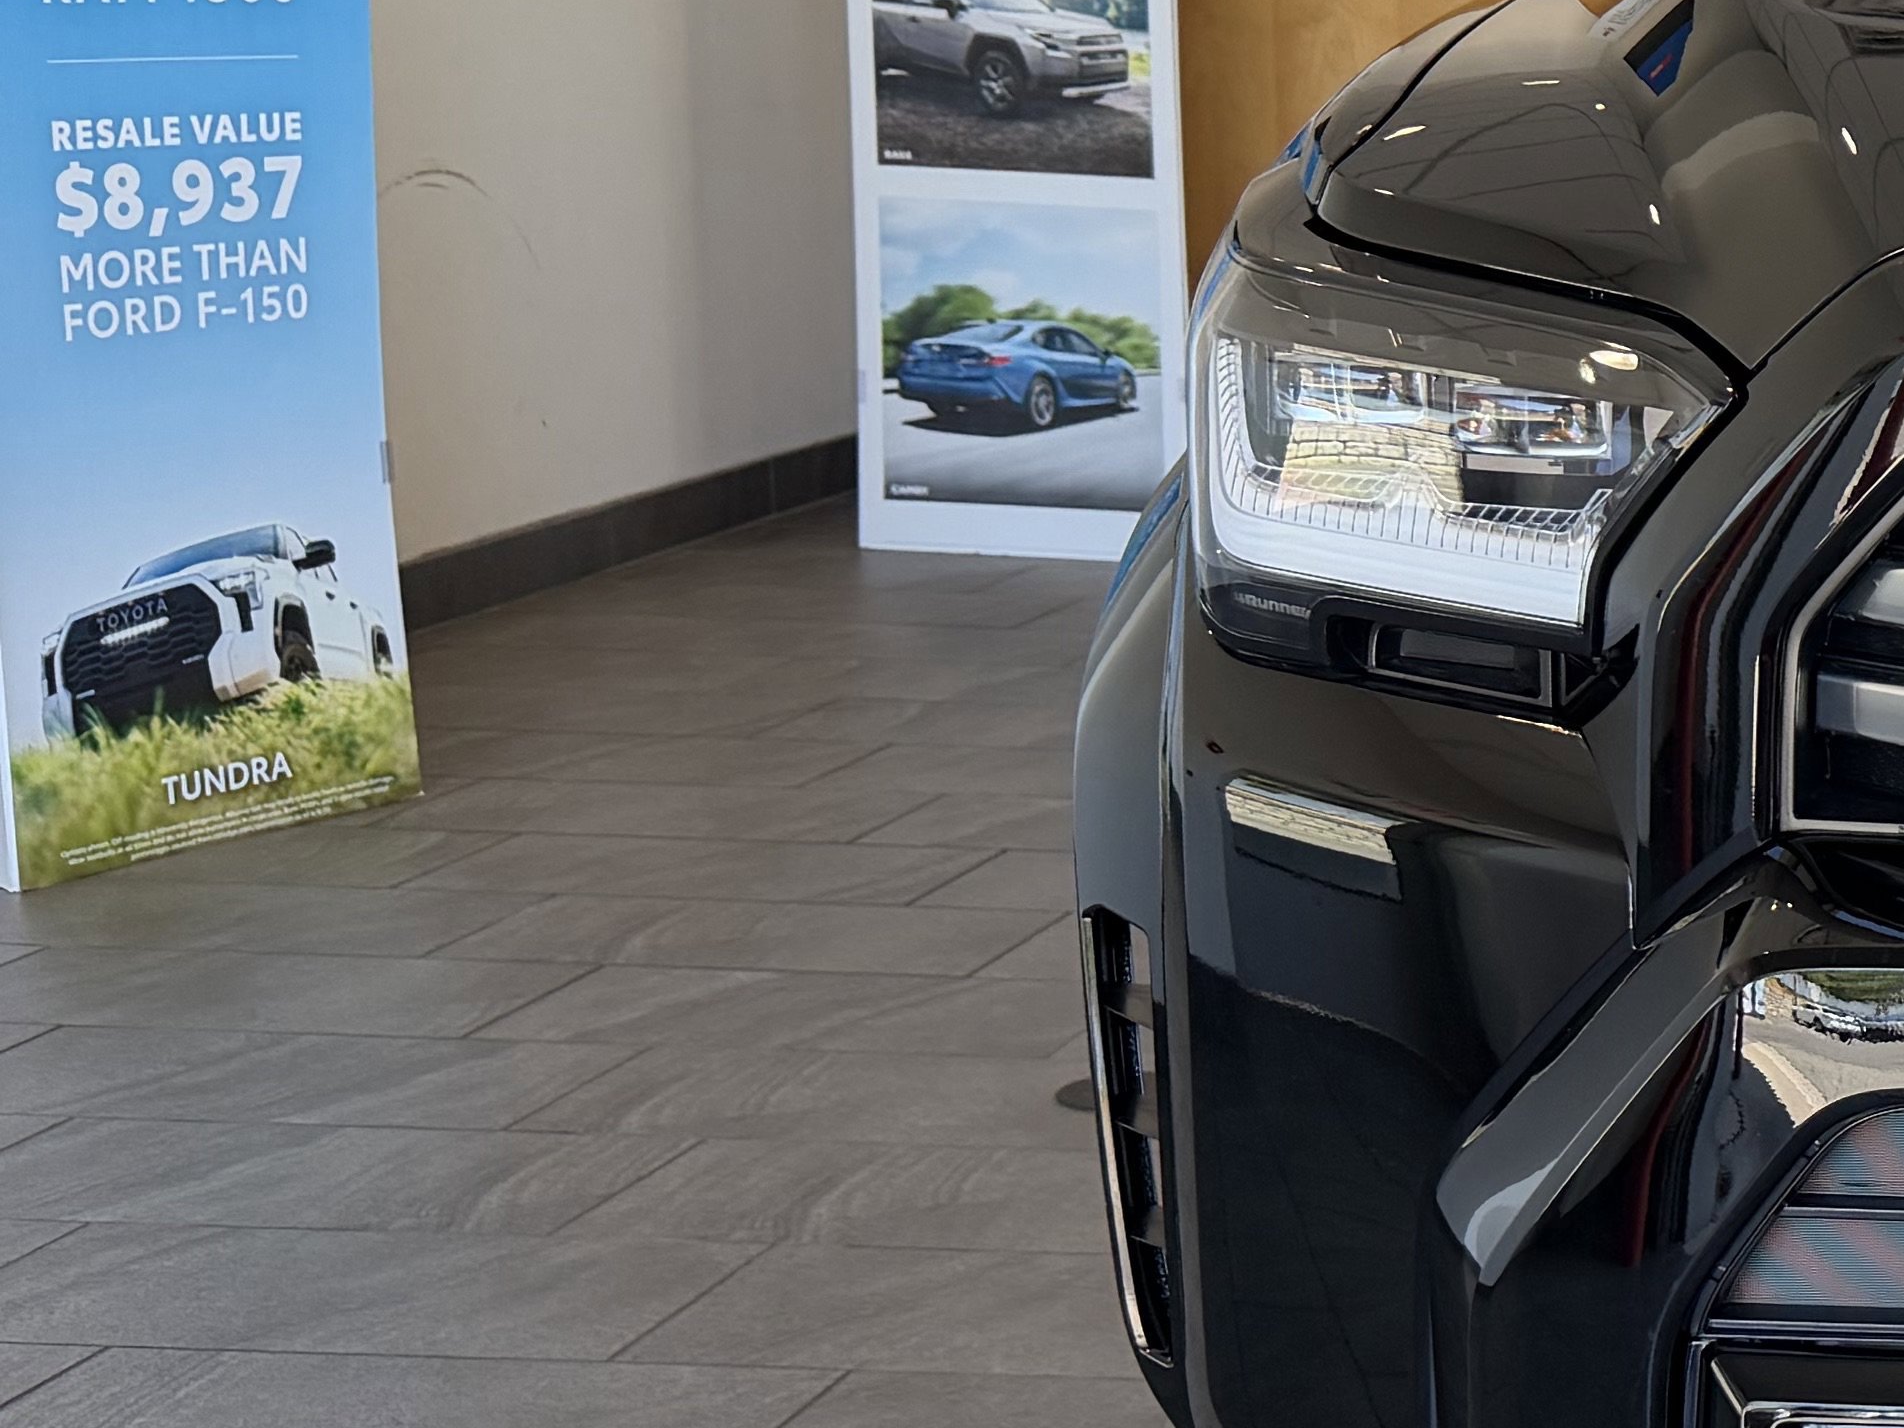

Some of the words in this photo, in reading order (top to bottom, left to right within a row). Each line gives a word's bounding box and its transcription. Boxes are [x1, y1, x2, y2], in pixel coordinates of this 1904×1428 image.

[50, 115, 183, 152] RESALE
[191, 111, 303, 145] VALUE
[55, 154, 304, 238] $8,937
[59, 246, 183, 294] MORE
[193, 236, 309, 281] THAN
[62, 289, 182, 343] FORD
[197, 283, 309, 331] F-150
[96, 597, 168, 633] TOYOTA
[161, 751, 293, 805] TUNDRA
